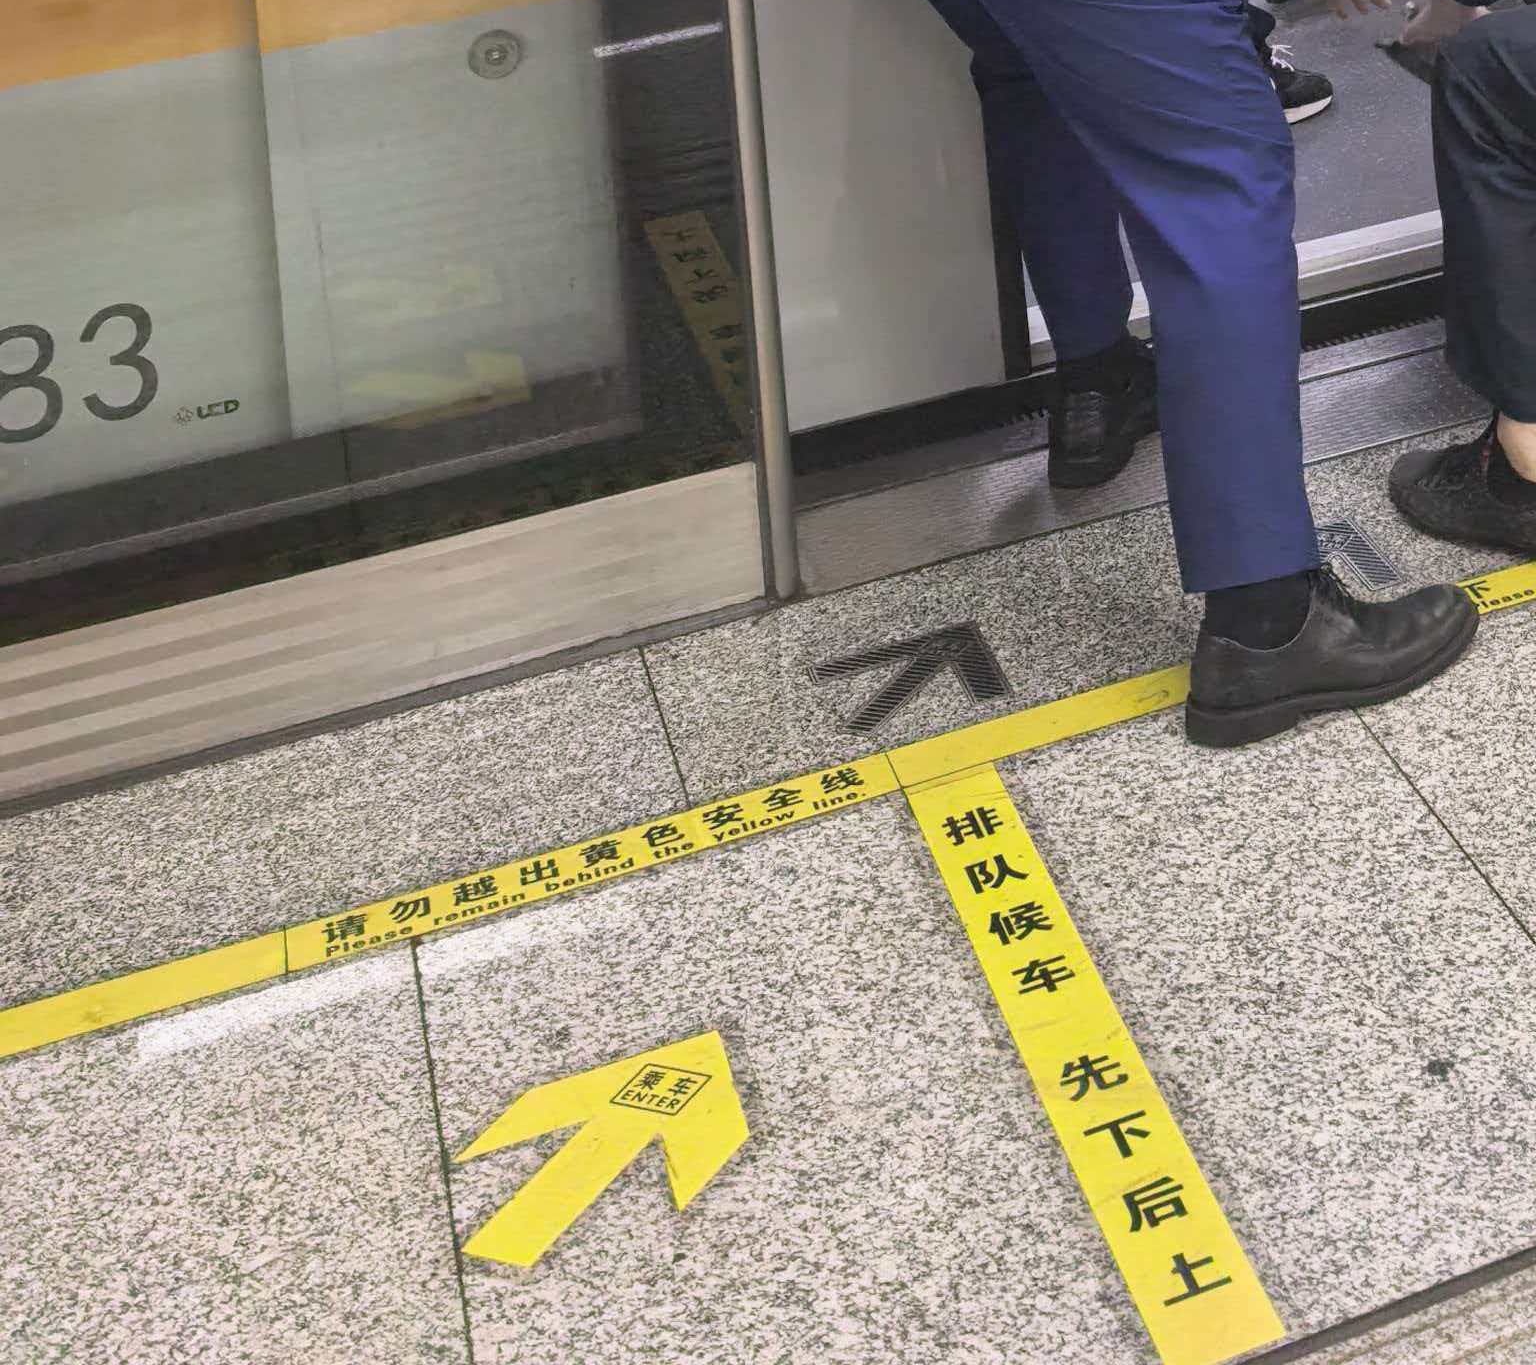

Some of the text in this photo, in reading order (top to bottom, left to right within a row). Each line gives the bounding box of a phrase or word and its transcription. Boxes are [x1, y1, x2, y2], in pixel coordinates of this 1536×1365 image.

[322, 768, 864, 943] 请勿越出黄色安全线
[325, 791, 866, 957] Please remain behind the yellow line.
[620, 1089, 681, 1109] ENTER
[633, 1070, 697, 1096] 乘车
[943, 805, 1232, 1307] 排队候车 先下后上
